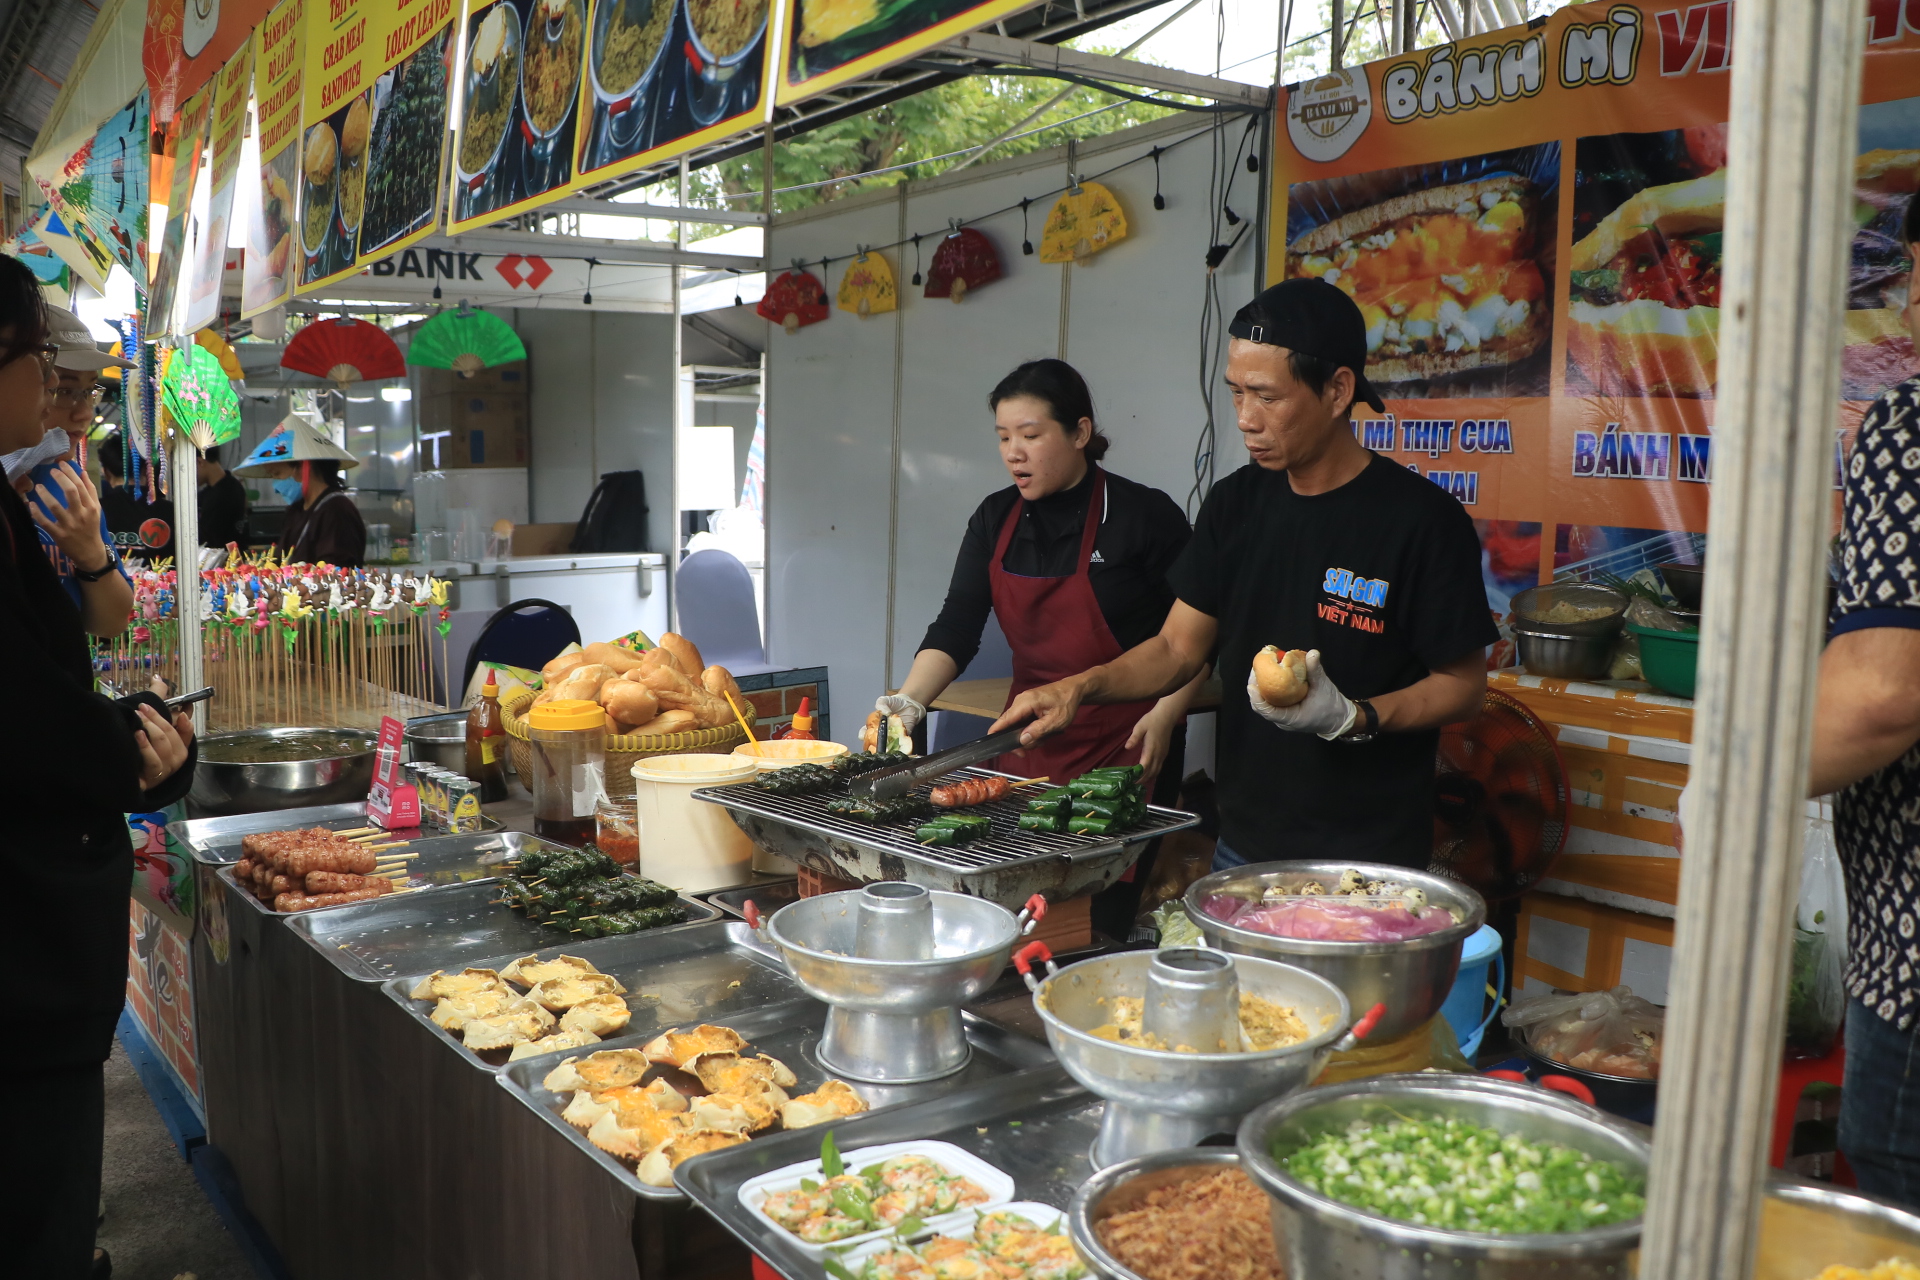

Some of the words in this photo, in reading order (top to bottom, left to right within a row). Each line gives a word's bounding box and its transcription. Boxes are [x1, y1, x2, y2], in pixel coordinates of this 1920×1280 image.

[323, 36, 345, 71] CRAB
[345, 17, 366, 56] MEAT
[385, 16, 417, 63] LOLOT
[416, 0, 452, 41] LEAVES
[321, 59, 362, 109] SANDWICH
[1382, 42, 1546, 124] BÁNH
[1558, 4, 1644, 89] MÌ
[1306, 103, 1336, 119] BÁNH
[373, 249, 483, 280] BANK
[1362, 413, 1395, 451] MÌ
[1400, 419, 1456, 459] THỊT
[1458, 419, 1513, 453] CUA
[1572, 422, 1671, 480] BÁNH
[1677, 425, 1715, 482] M
[1350, 613, 1384, 634] NAM
